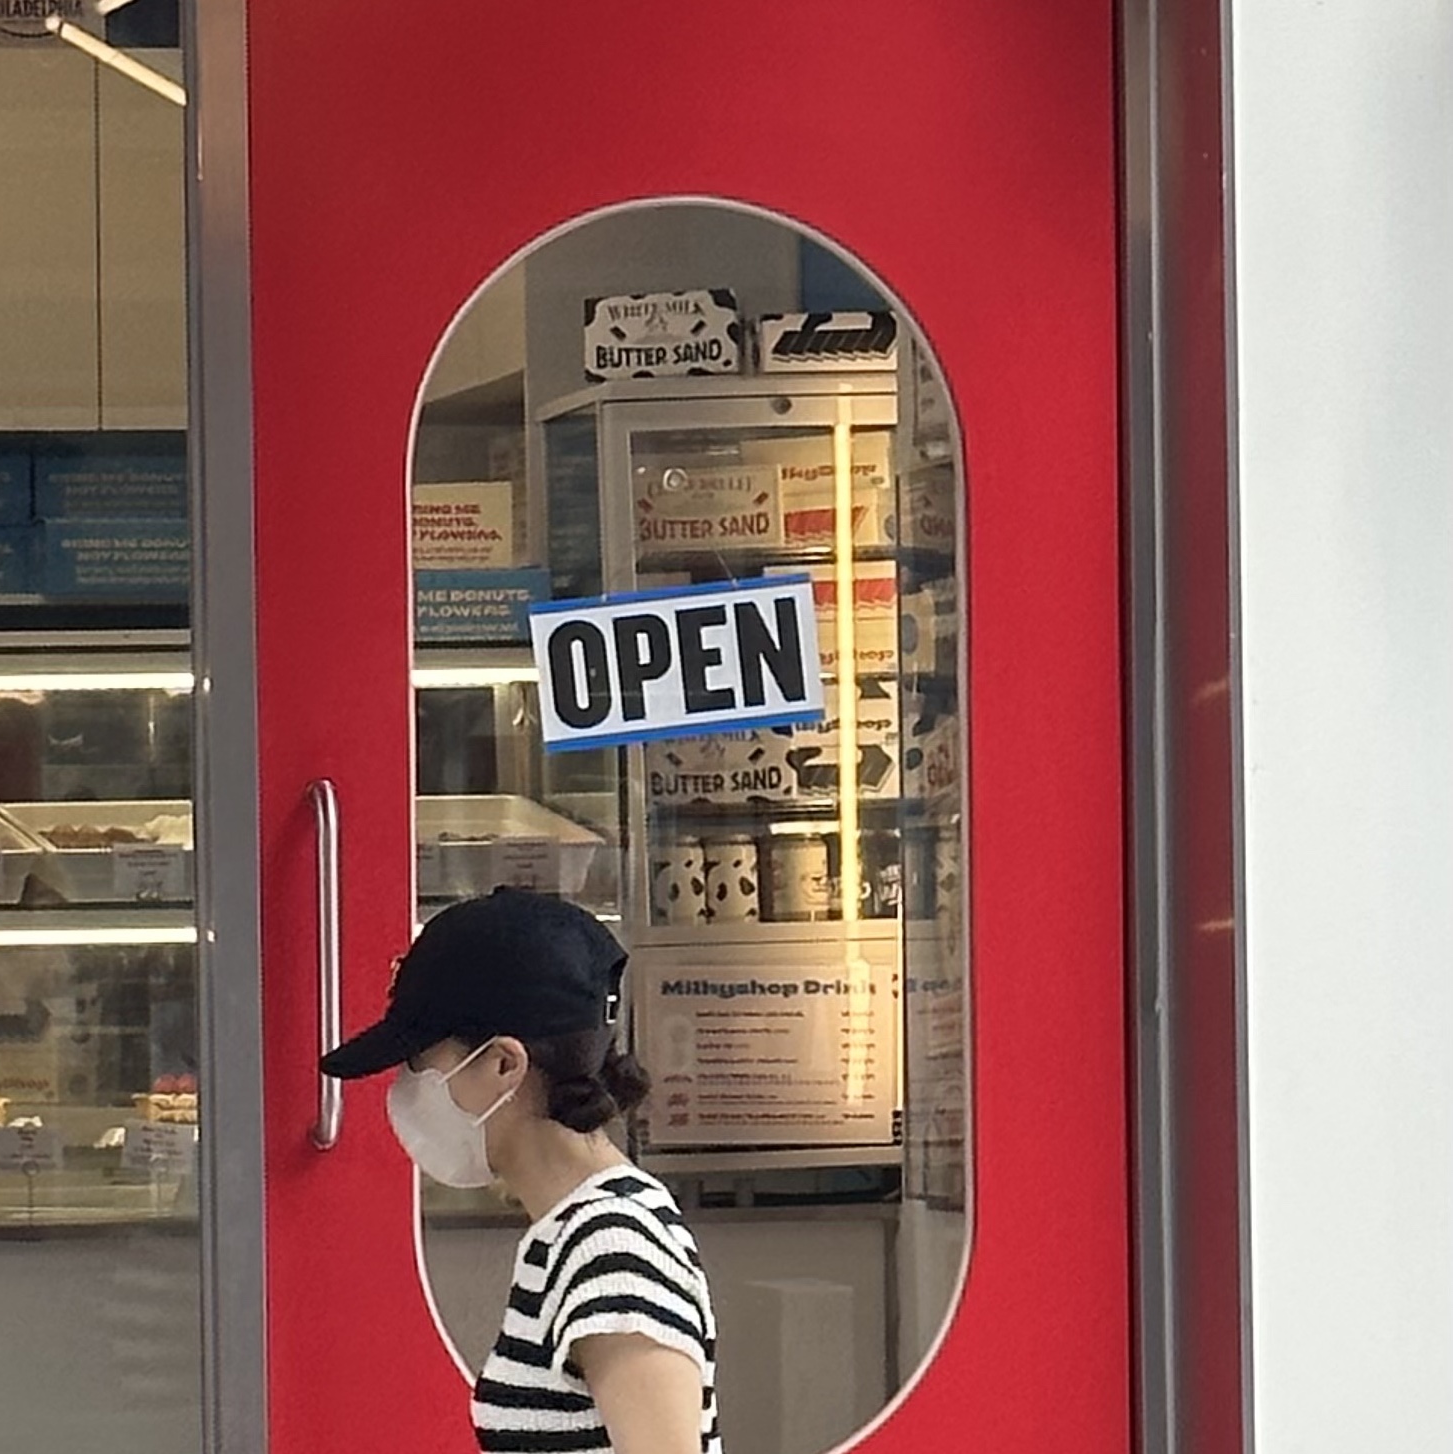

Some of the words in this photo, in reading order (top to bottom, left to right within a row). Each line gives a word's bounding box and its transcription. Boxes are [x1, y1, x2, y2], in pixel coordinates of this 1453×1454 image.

[596, 345, 667, 369] BUTTER
[673, 338, 722, 365] SAND
[718, 512, 771, 537] SAND
[548, 597, 806, 729] OPEN
[651, 771, 724, 796] BUTTER
[731, 766, 782, 791] SAND
